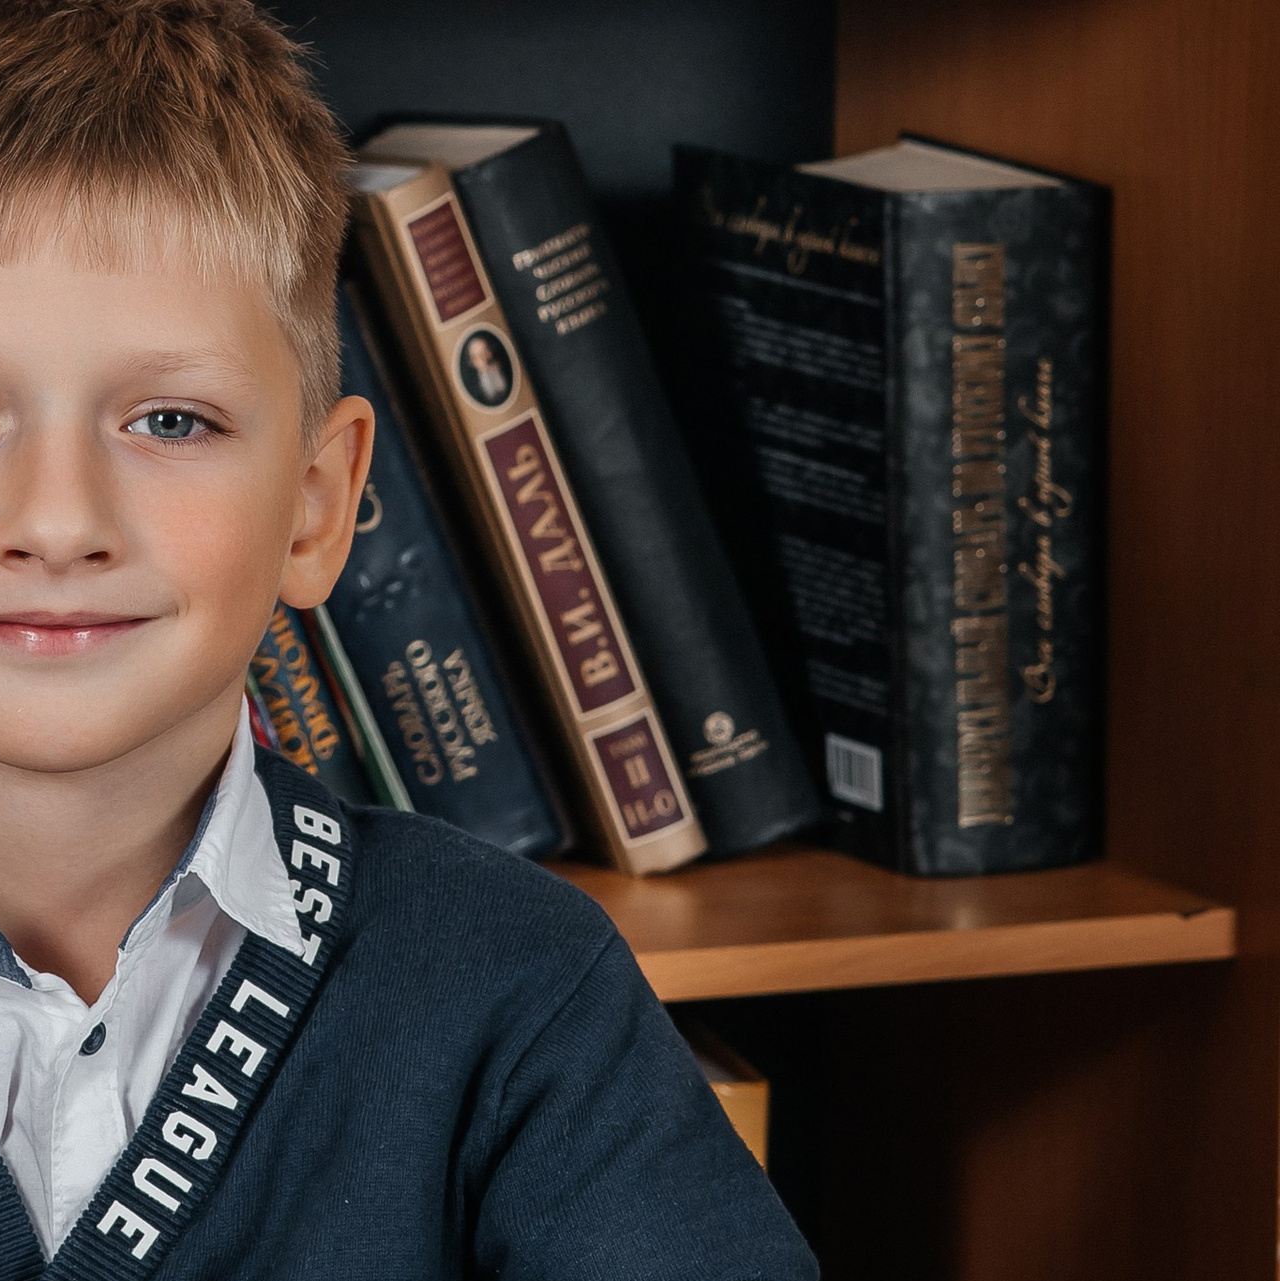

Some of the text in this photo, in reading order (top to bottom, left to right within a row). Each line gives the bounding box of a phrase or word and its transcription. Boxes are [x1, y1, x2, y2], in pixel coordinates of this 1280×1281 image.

[505, 440, 586, 578] ДАЛЬ
[380, 660, 445, 786] СЛОВАРЬ
[405, 639, 479, 783] РУССКОГО
[290, 804, 342, 966] BEST
[96, 978, 290, 1261] LEAGUE
